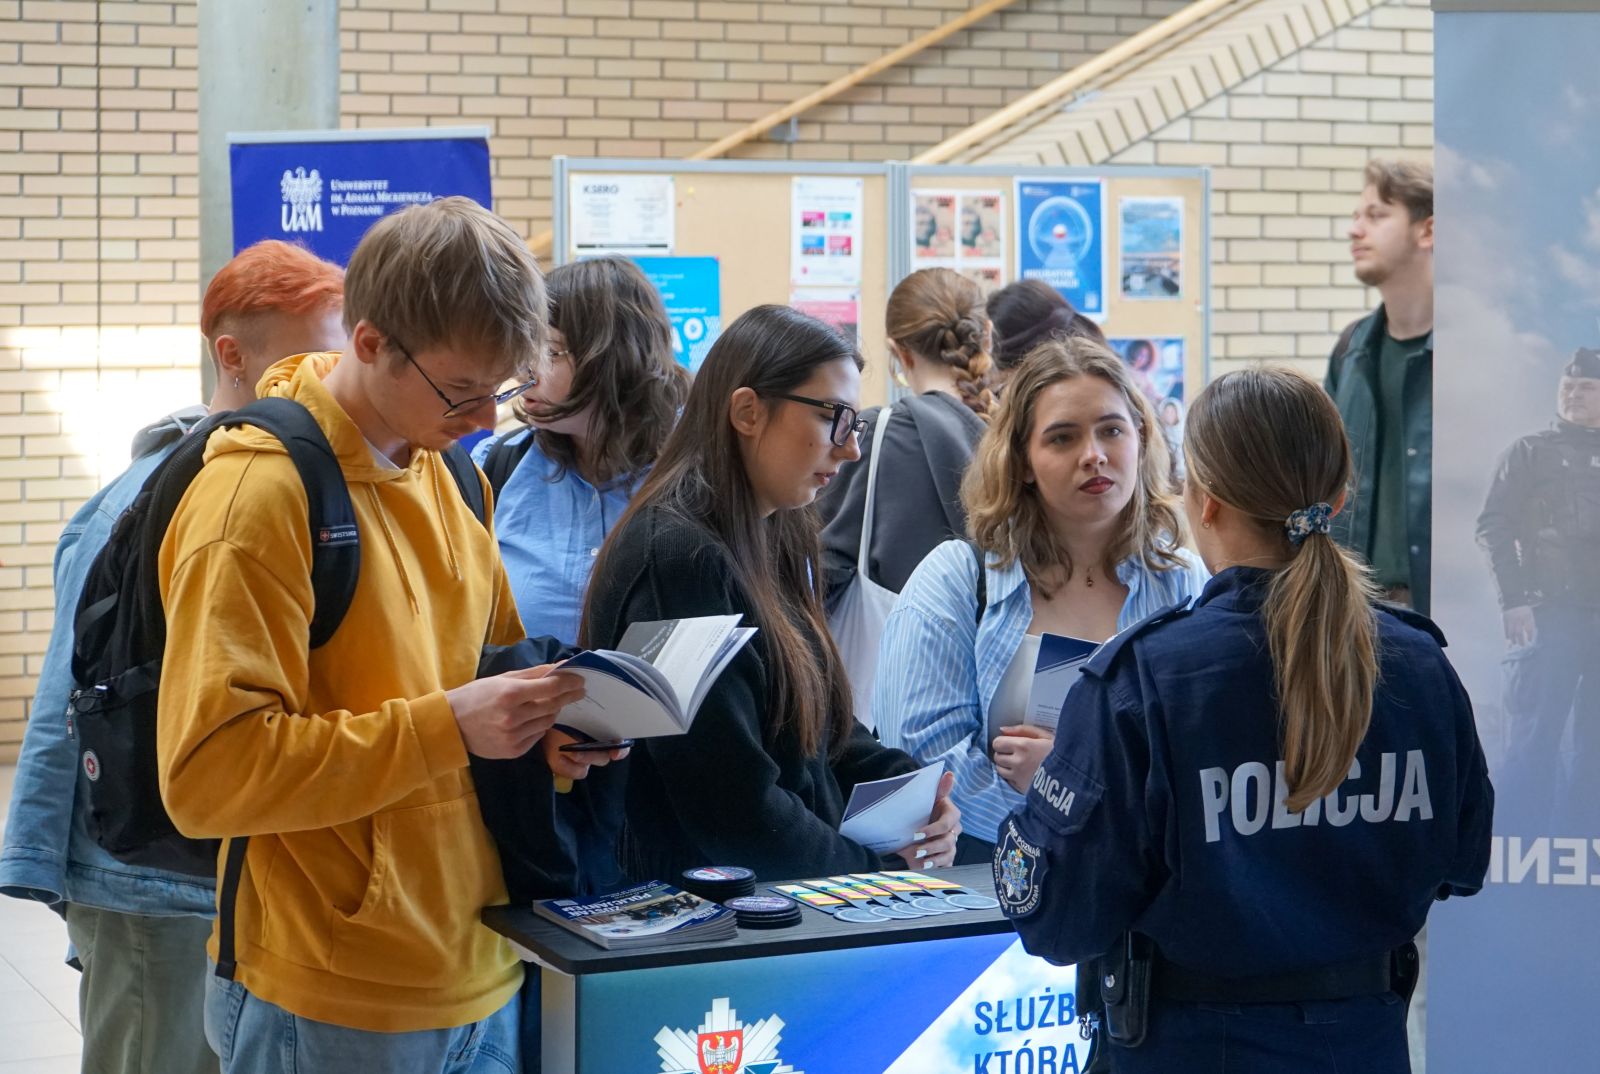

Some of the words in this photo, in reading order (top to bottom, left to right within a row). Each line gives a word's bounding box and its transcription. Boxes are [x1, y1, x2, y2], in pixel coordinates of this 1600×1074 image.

[281, 203, 323, 232] UAM
[1033, 766, 1076, 816] OLICJA
[1017, 836, 1041, 857] POZNAŃ
[974, 986, 1076, 1036] SŁUŻB
